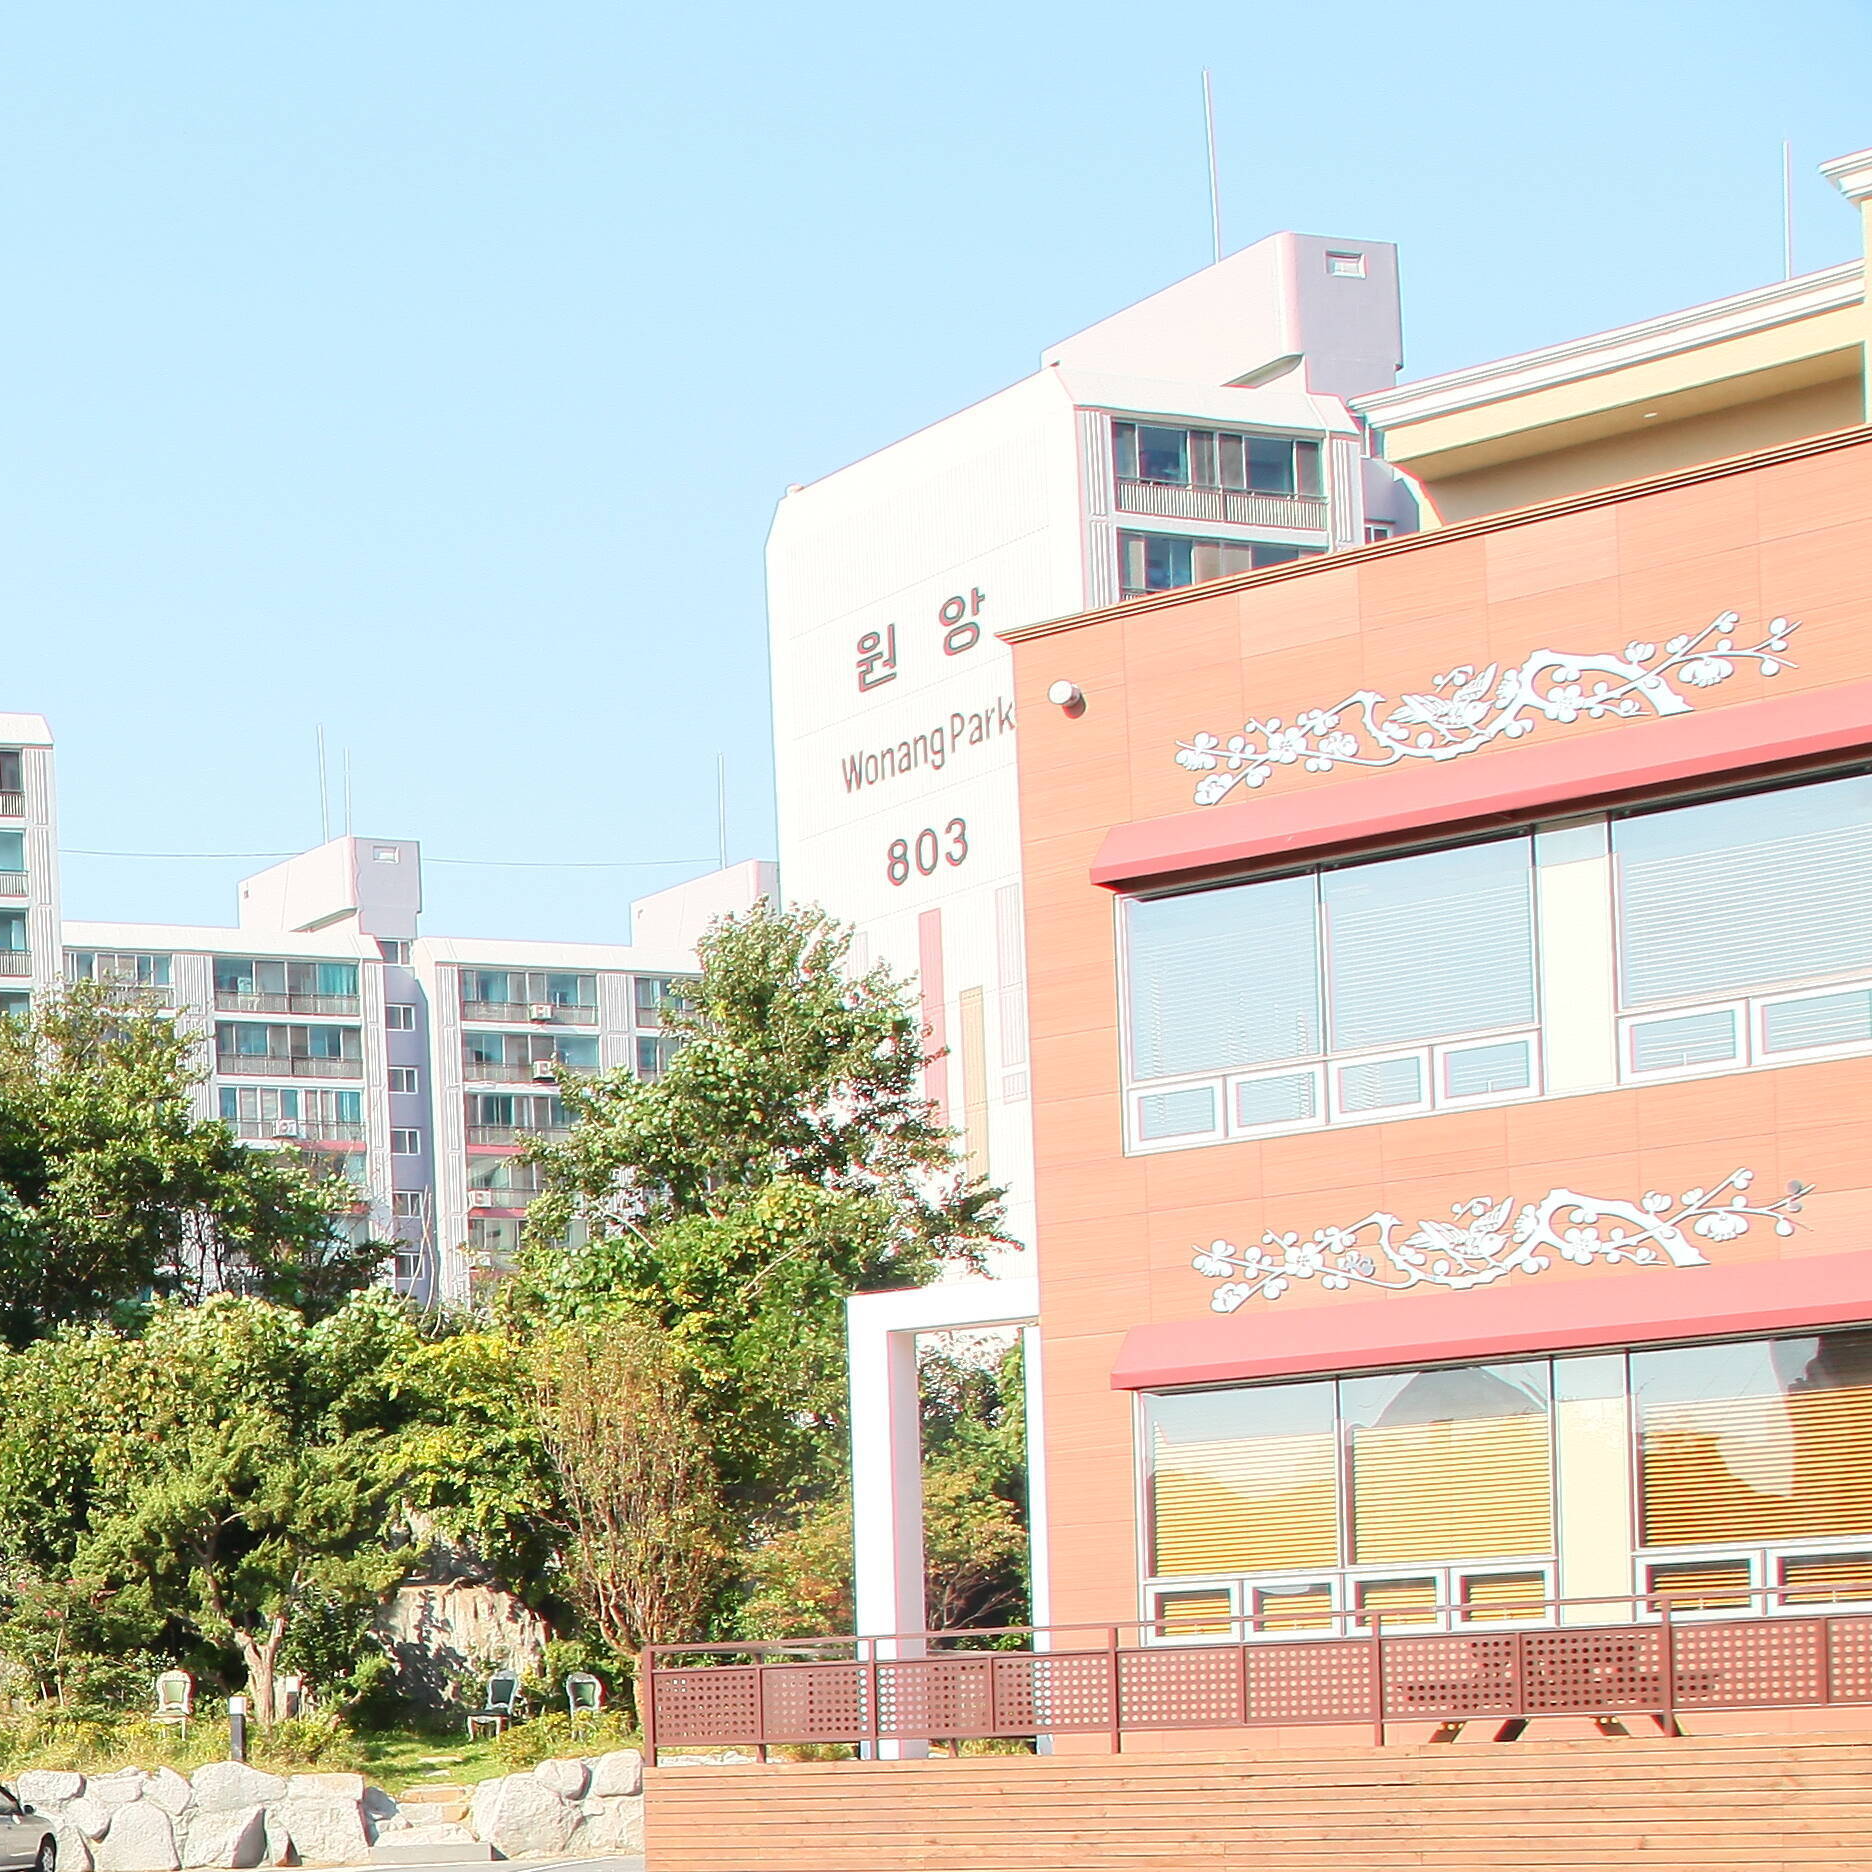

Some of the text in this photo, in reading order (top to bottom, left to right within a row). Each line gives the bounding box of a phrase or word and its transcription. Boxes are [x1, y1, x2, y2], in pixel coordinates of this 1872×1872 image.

[841, 696, 1016, 794] Wonang Park
[886, 817, 969, 886] 803
